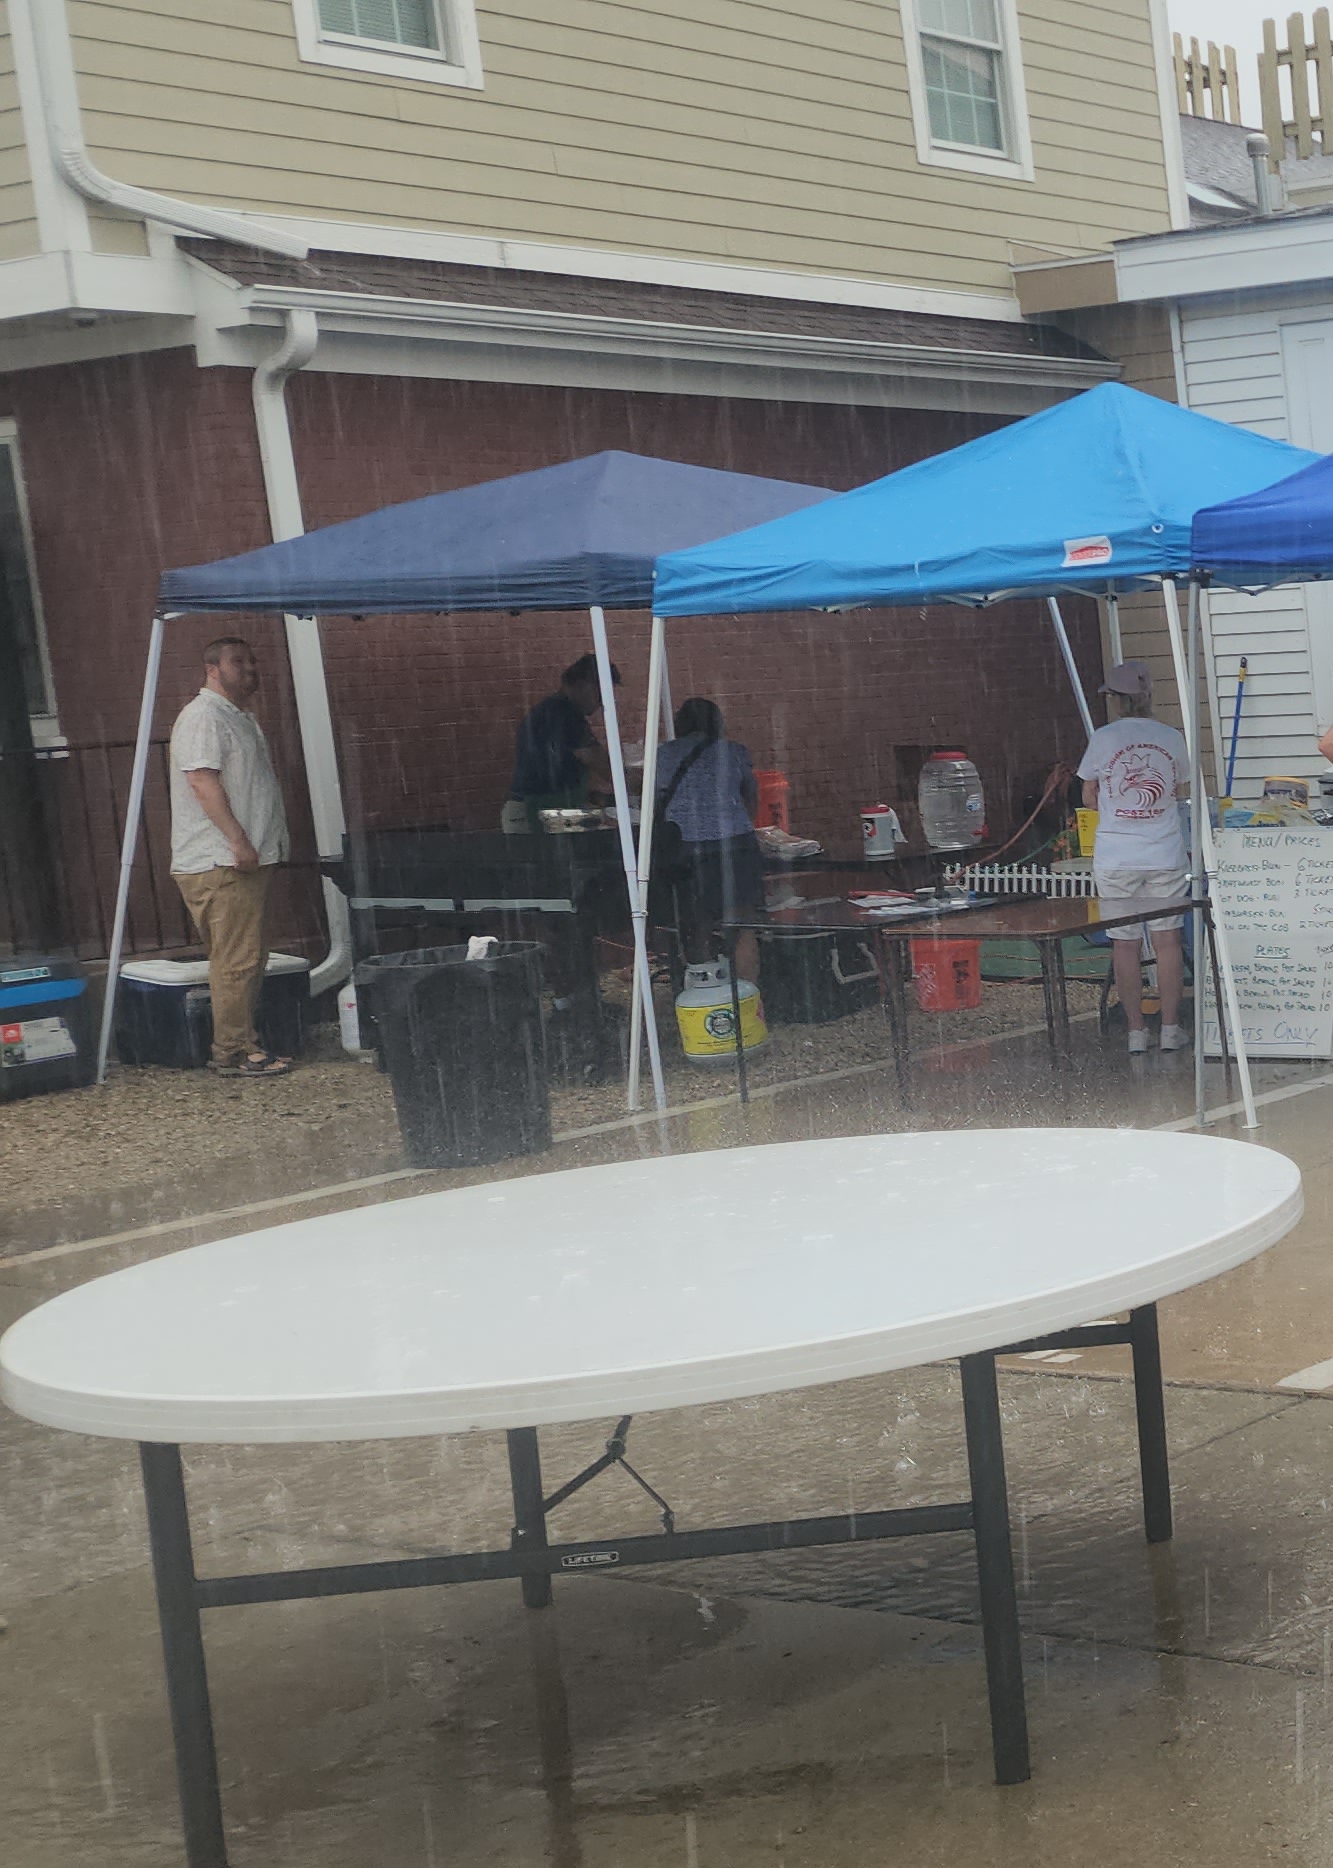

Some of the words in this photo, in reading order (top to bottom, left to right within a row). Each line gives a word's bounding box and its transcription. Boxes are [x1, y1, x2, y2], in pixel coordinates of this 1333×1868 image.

[1137, 743, 1173, 761] AMERICAN
[1297, 857, 1306, 871] 6
[1295, 873, 1301, 887] 6
[1271, 923, 1290, 932] COB
[1300, 920, 1306, 928] 2
[1256, 944, 1291, 957] PLATES
[1319, 1002, 1331, 1012] 10
[1273, 1021, 1318, 1041] ONLY
